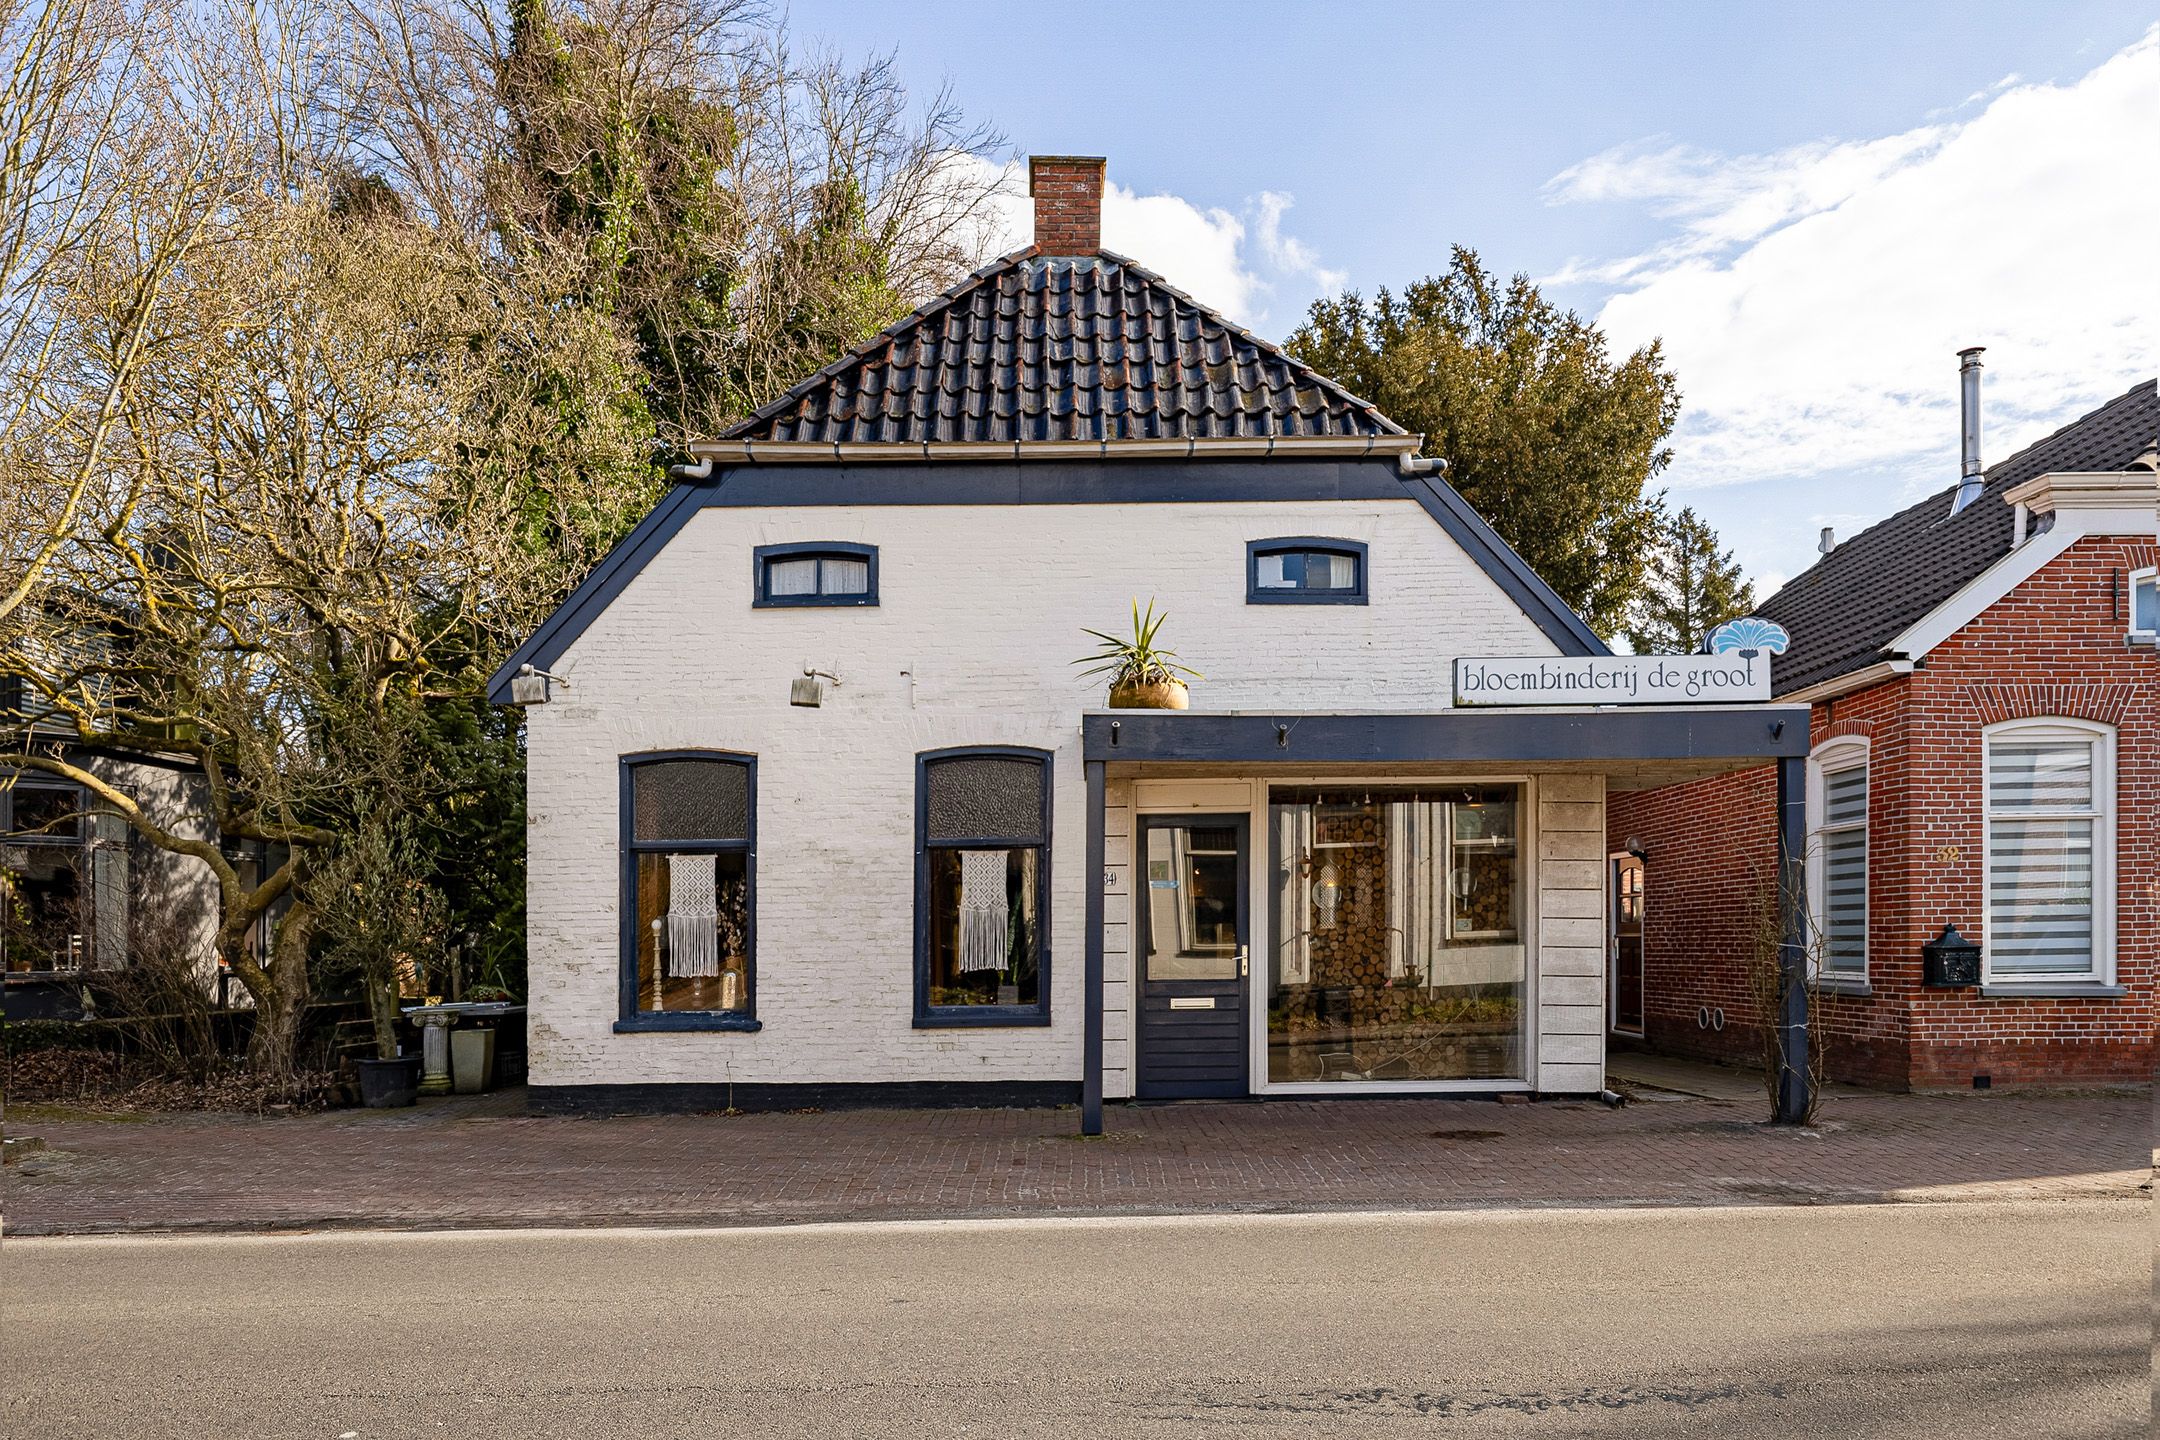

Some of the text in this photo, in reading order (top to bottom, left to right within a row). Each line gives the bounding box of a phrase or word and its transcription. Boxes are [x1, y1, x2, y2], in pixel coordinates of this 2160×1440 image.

[1463, 660, 1757, 697] bloembinderij de groot
